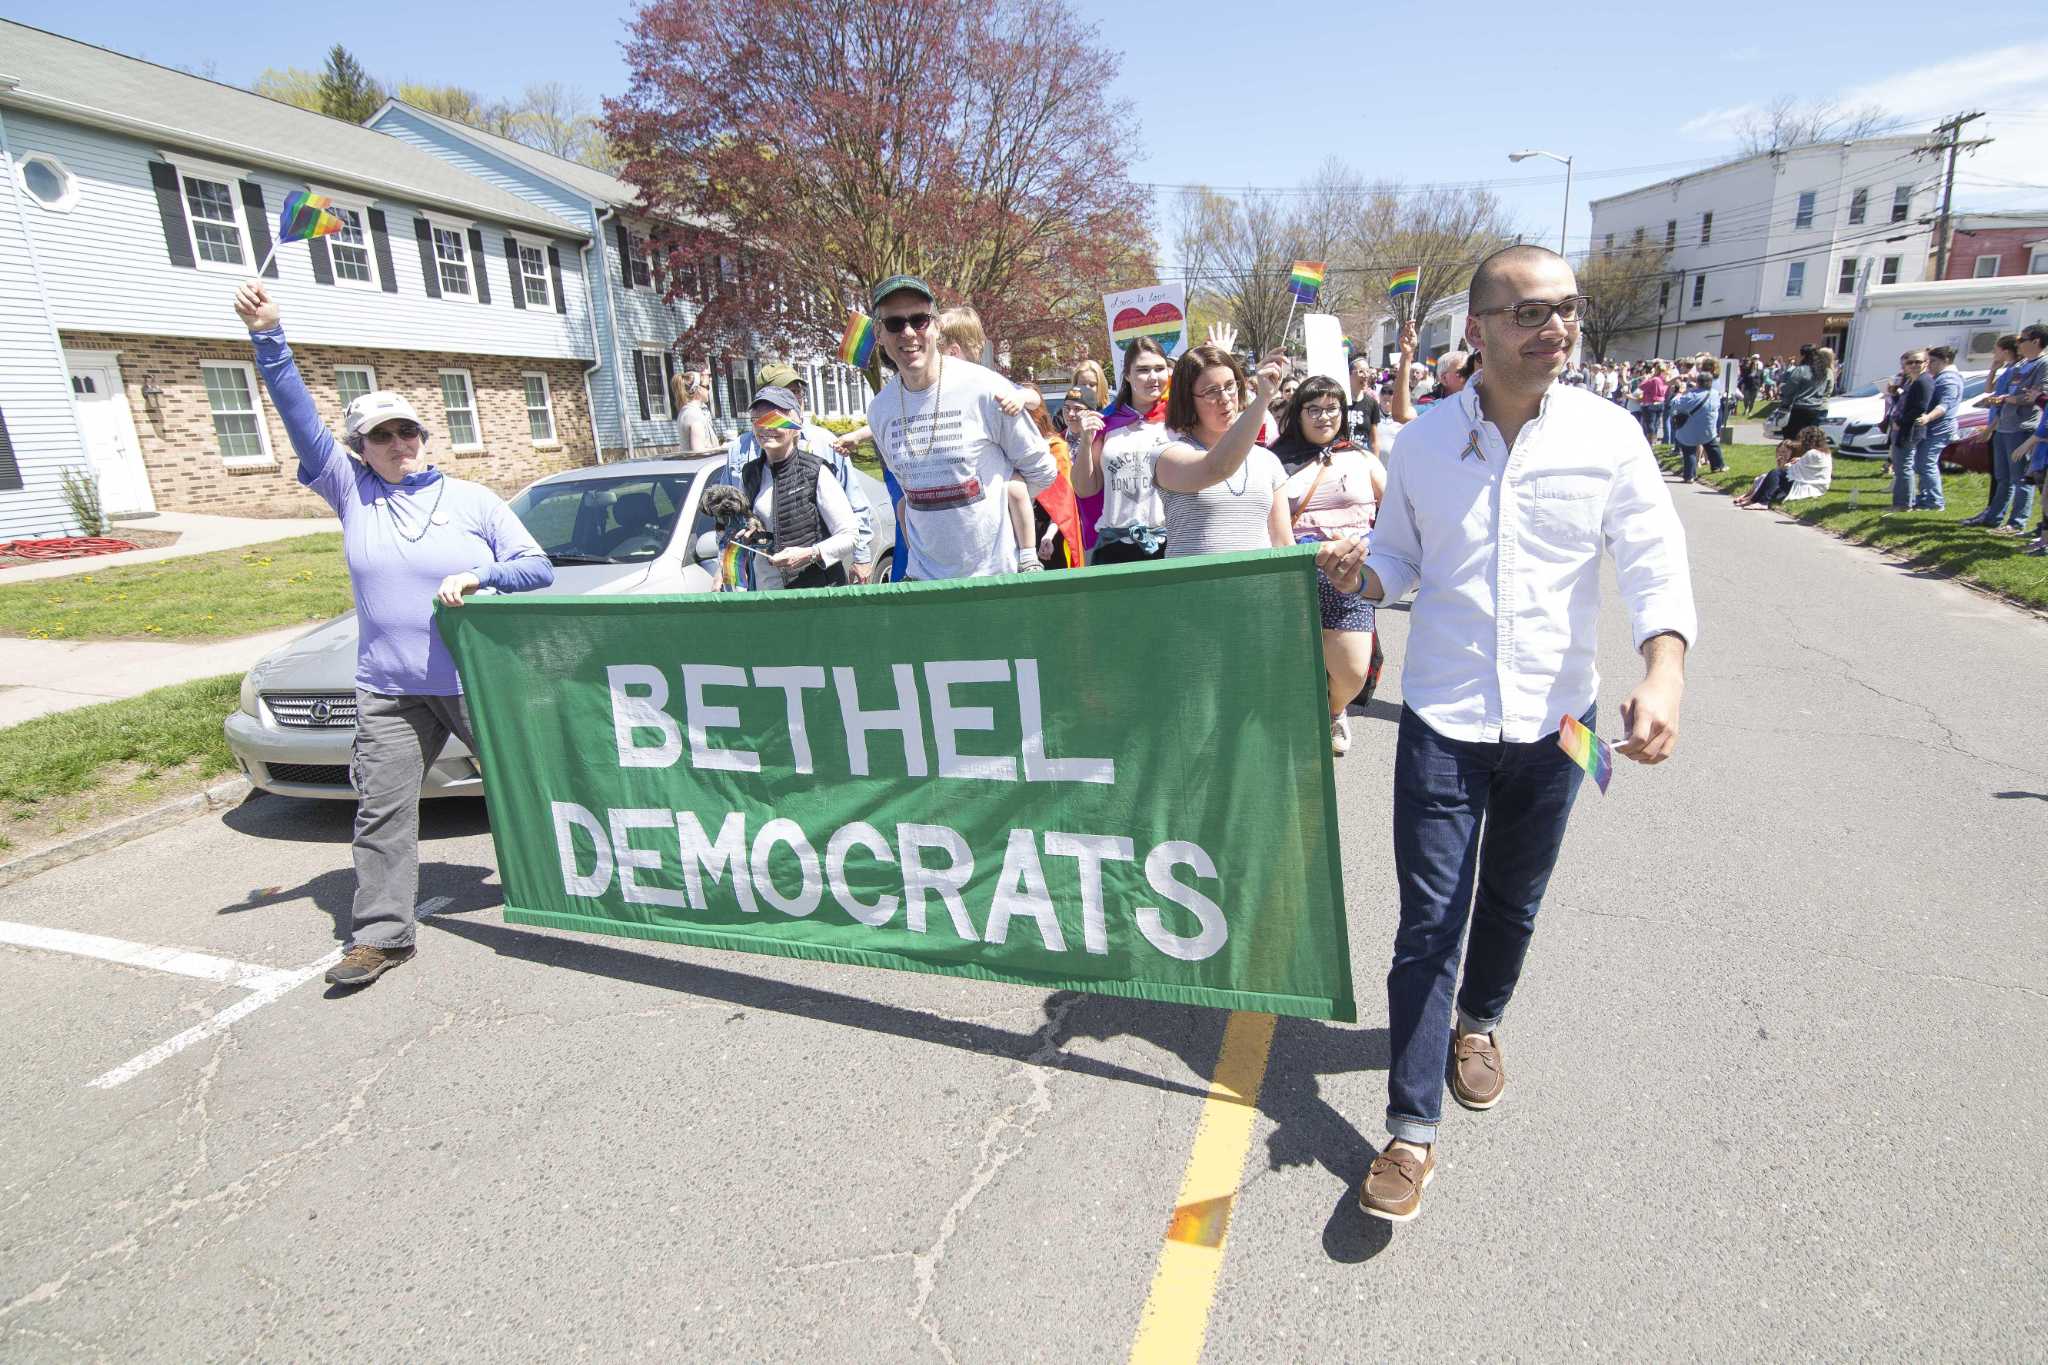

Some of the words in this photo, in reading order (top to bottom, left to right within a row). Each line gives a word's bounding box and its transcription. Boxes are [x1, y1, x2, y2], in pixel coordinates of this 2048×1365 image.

[1902, 310, 1950, 321] Beyond
[1954, 308, 1974, 318] the
[1979, 307, 2008, 317] Flea
[1107, 450, 1138, 474] BEACH
[1111, 477, 1137, 491] DON'T
[606, 659, 1115, 784] BETHEL
[551, 801, 1228, 961] DEMOCRATS
